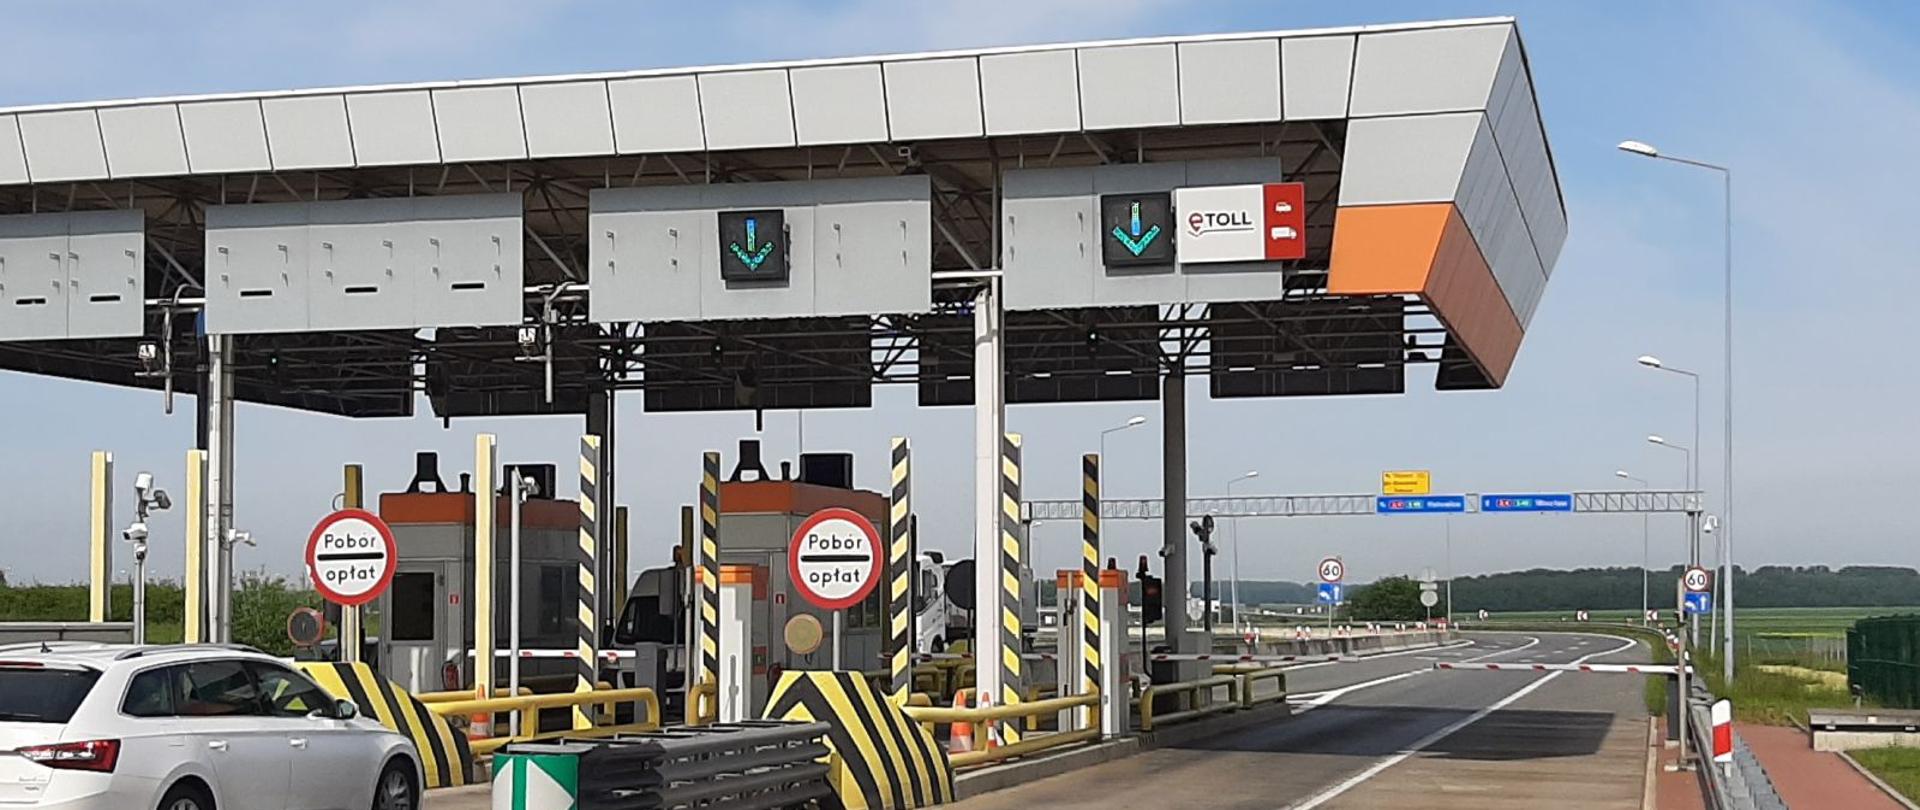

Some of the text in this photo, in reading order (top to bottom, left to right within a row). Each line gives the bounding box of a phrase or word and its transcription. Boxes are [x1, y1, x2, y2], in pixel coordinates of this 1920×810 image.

[324, 532, 376, 549] Pobór
[808, 533, 862, 550] Pobór
[326, 565, 375, 585] opłat
[809, 568, 860, 588] opłat
[1323, 564, 1340, 576] 60
[1687, 574, 1705, 586] 60
